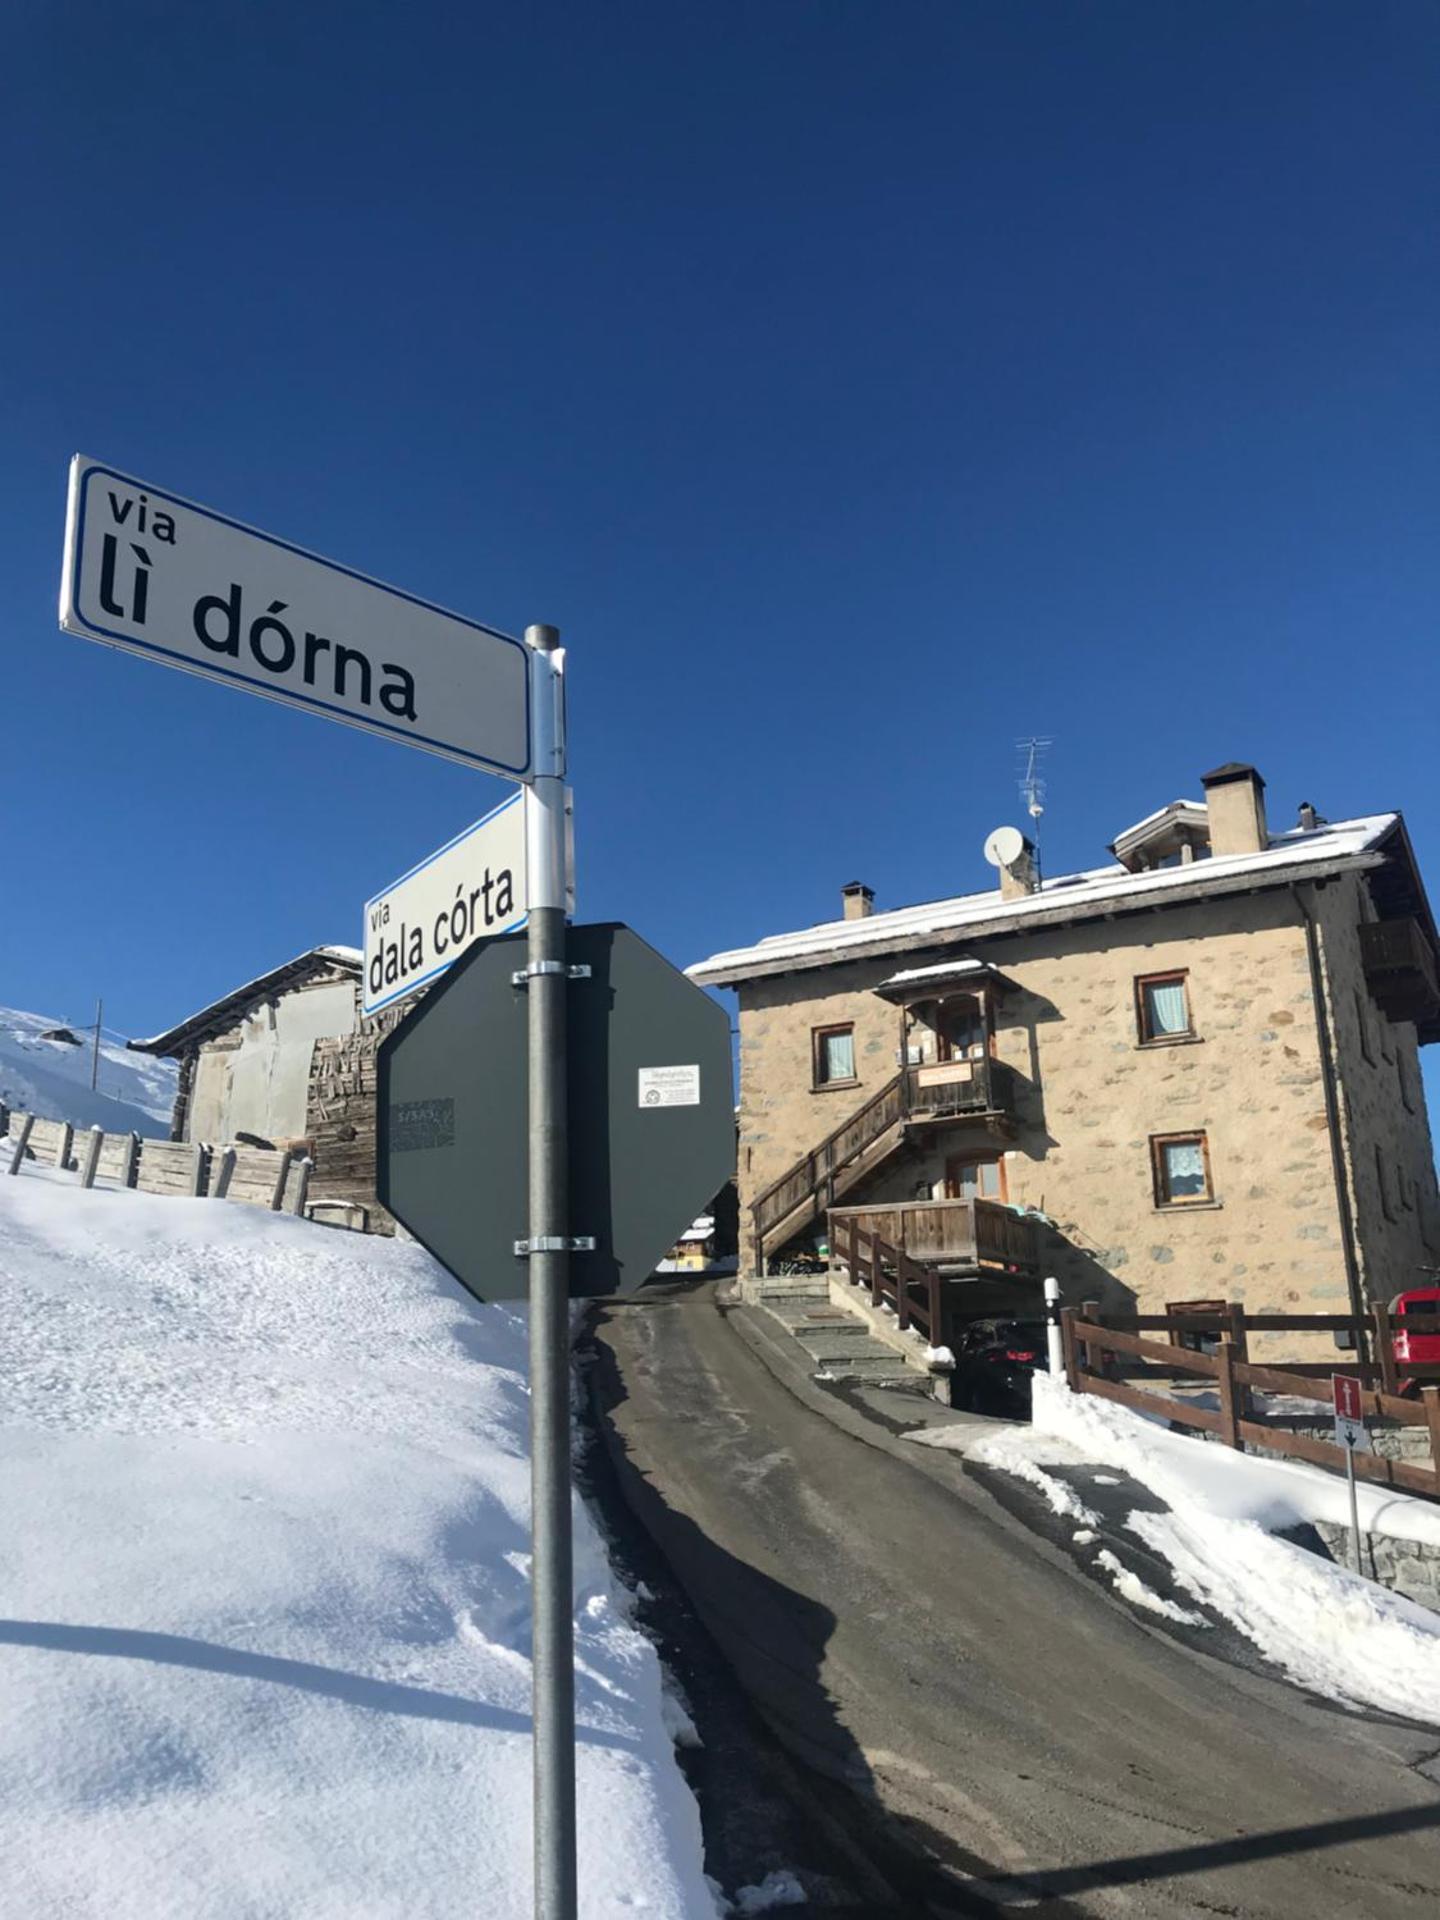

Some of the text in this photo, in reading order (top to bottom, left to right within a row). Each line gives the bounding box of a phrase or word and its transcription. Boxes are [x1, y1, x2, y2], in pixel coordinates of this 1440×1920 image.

[108, 491, 176, 545] via
[99, 533, 418, 722] lì dórna
[369, 867, 514, 995] dala córta
[370, 902, 390, 933] via
